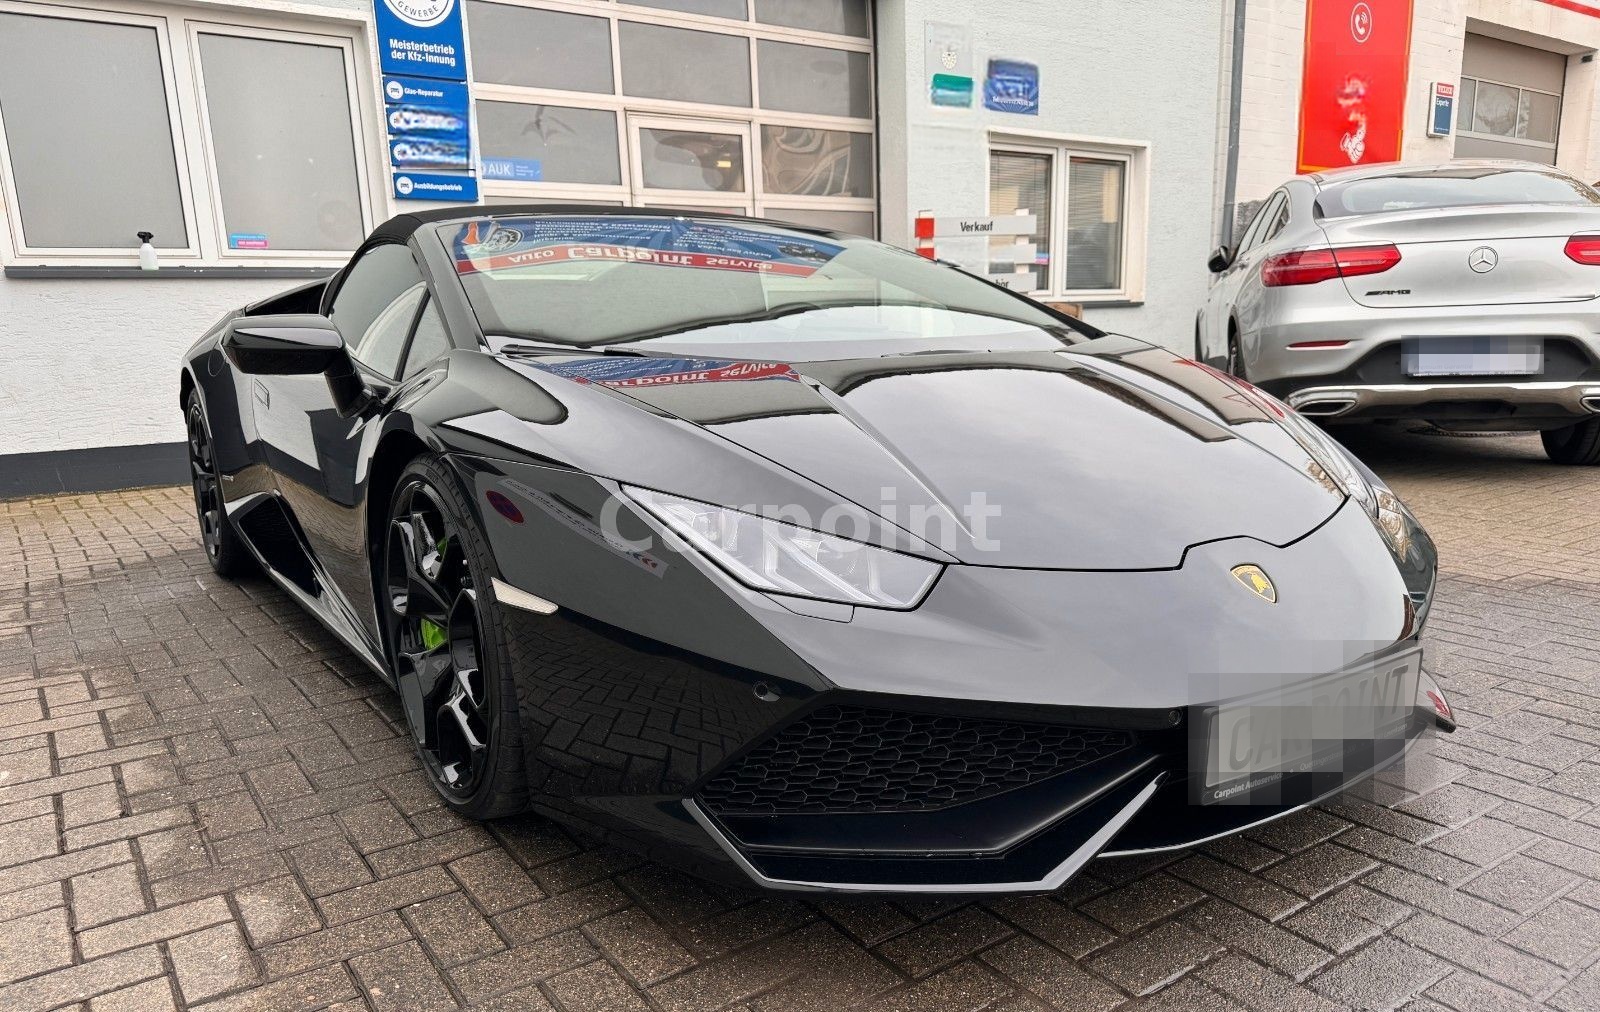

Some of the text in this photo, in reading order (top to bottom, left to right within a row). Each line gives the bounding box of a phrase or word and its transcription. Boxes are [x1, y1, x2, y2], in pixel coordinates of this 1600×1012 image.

[397, 1, 439, 17] GEWERBE
[389, 38, 455, 55] Meisterbetrieb
[391, 50, 456, 67] der Kfz-Innung
[404, 87, 444, 97] Glas-Reparatur
[488, 162, 511, 176] AUK
[414, 182, 463, 191] Ausbildungsbetrieb
[960, 221, 993, 232] Verkauf
[1214, 783, 1245, 799] Carpoint
[1245, 770, 1283, 790] Autoservice
